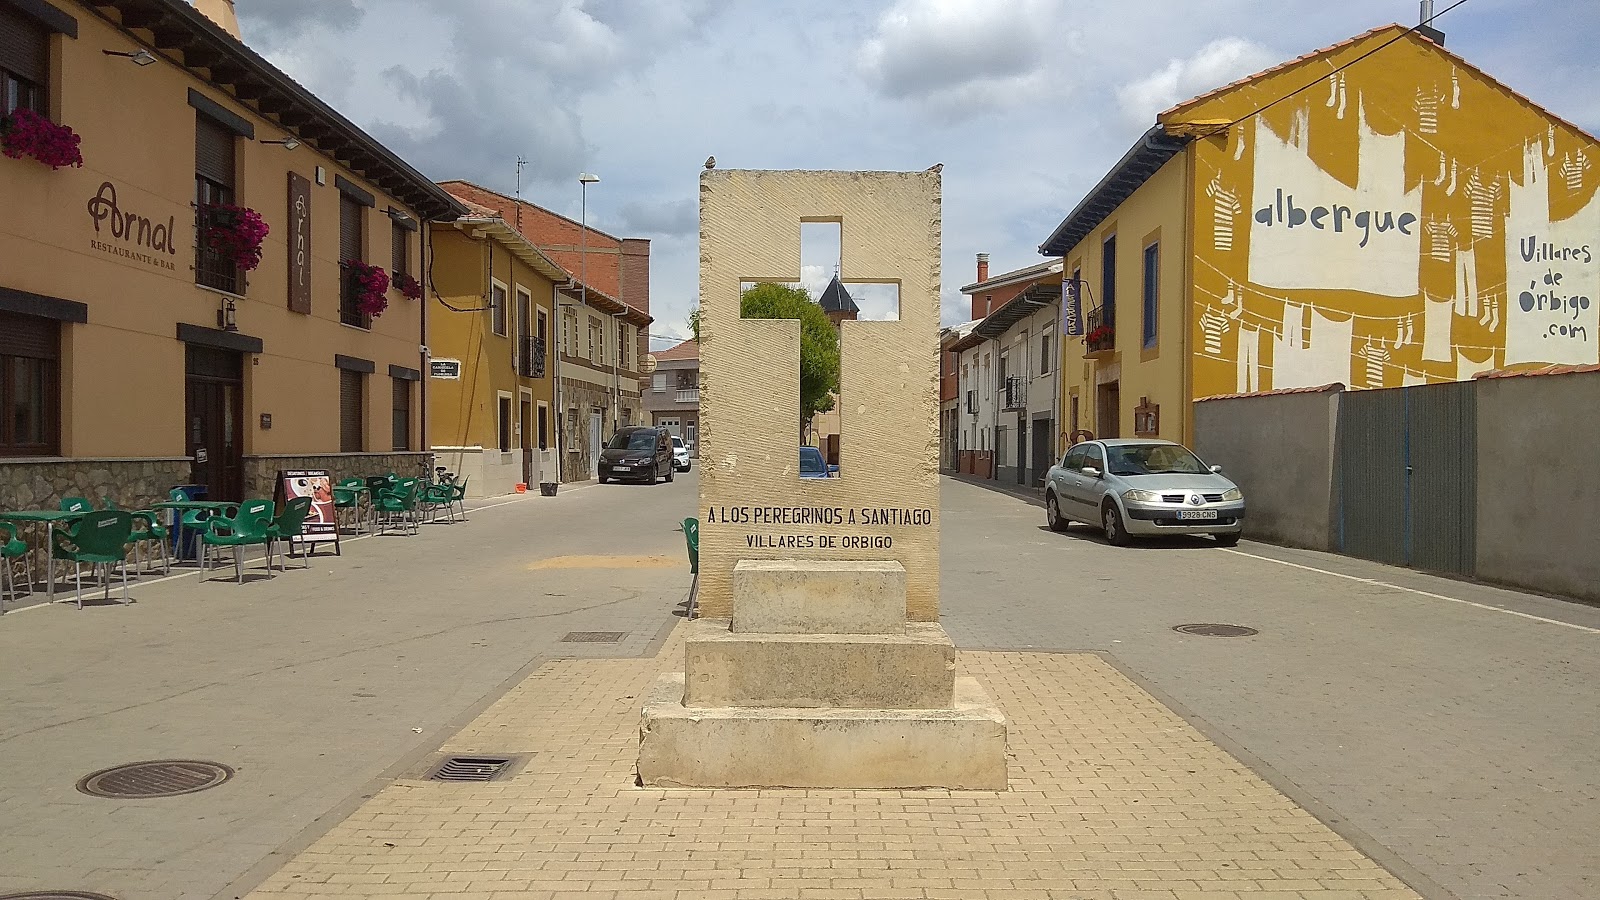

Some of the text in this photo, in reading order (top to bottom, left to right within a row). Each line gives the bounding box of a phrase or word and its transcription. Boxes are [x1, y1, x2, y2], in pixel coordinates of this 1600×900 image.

[87, 181, 176, 255] Arnal
[1254, 188, 1417, 249] albergue
[295, 194, 307, 286] Arnal
[1520, 235, 1592, 264] Villares
[91, 239, 176, 271] RESTAURANTE & BAR
[1543, 267, 1563, 287] de
[1519, 280, 1590, 321] Órbigo
[1542, 323, 1587, 342] .com
[707, 506, 932, 526] A LOS PEREGRINOS A SANTIAGO
[1202, 511, 1216, 519] CNS
[746, 534, 893, 549] VILLARES DE ORBIGO
